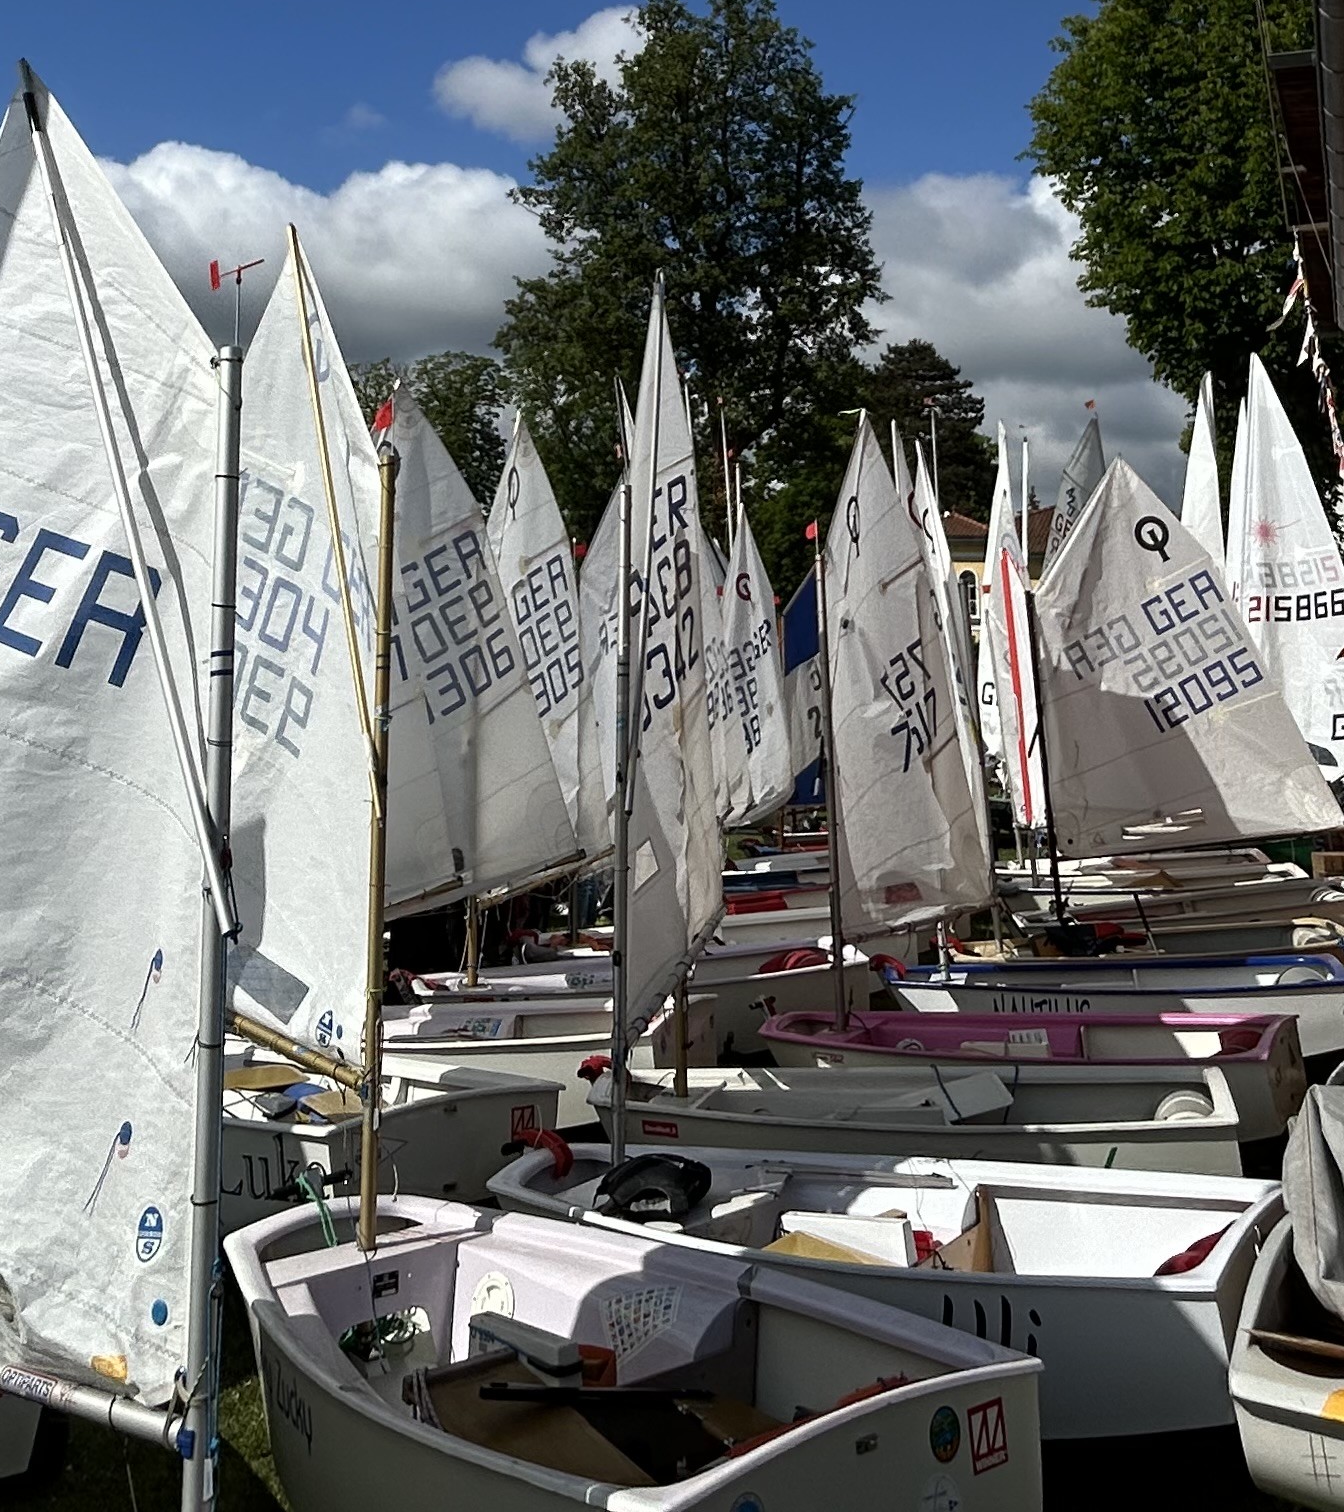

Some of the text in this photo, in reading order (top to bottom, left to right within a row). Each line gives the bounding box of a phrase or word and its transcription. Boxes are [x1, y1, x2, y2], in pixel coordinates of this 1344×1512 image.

[401, 530, 486, 613] GER
[512, 554, 568, 625] GER
[1141, 570, 1224, 635] GER
[1249, 588, 1344, 622] 215866
[1144, 647, 1264, 733] 12095
